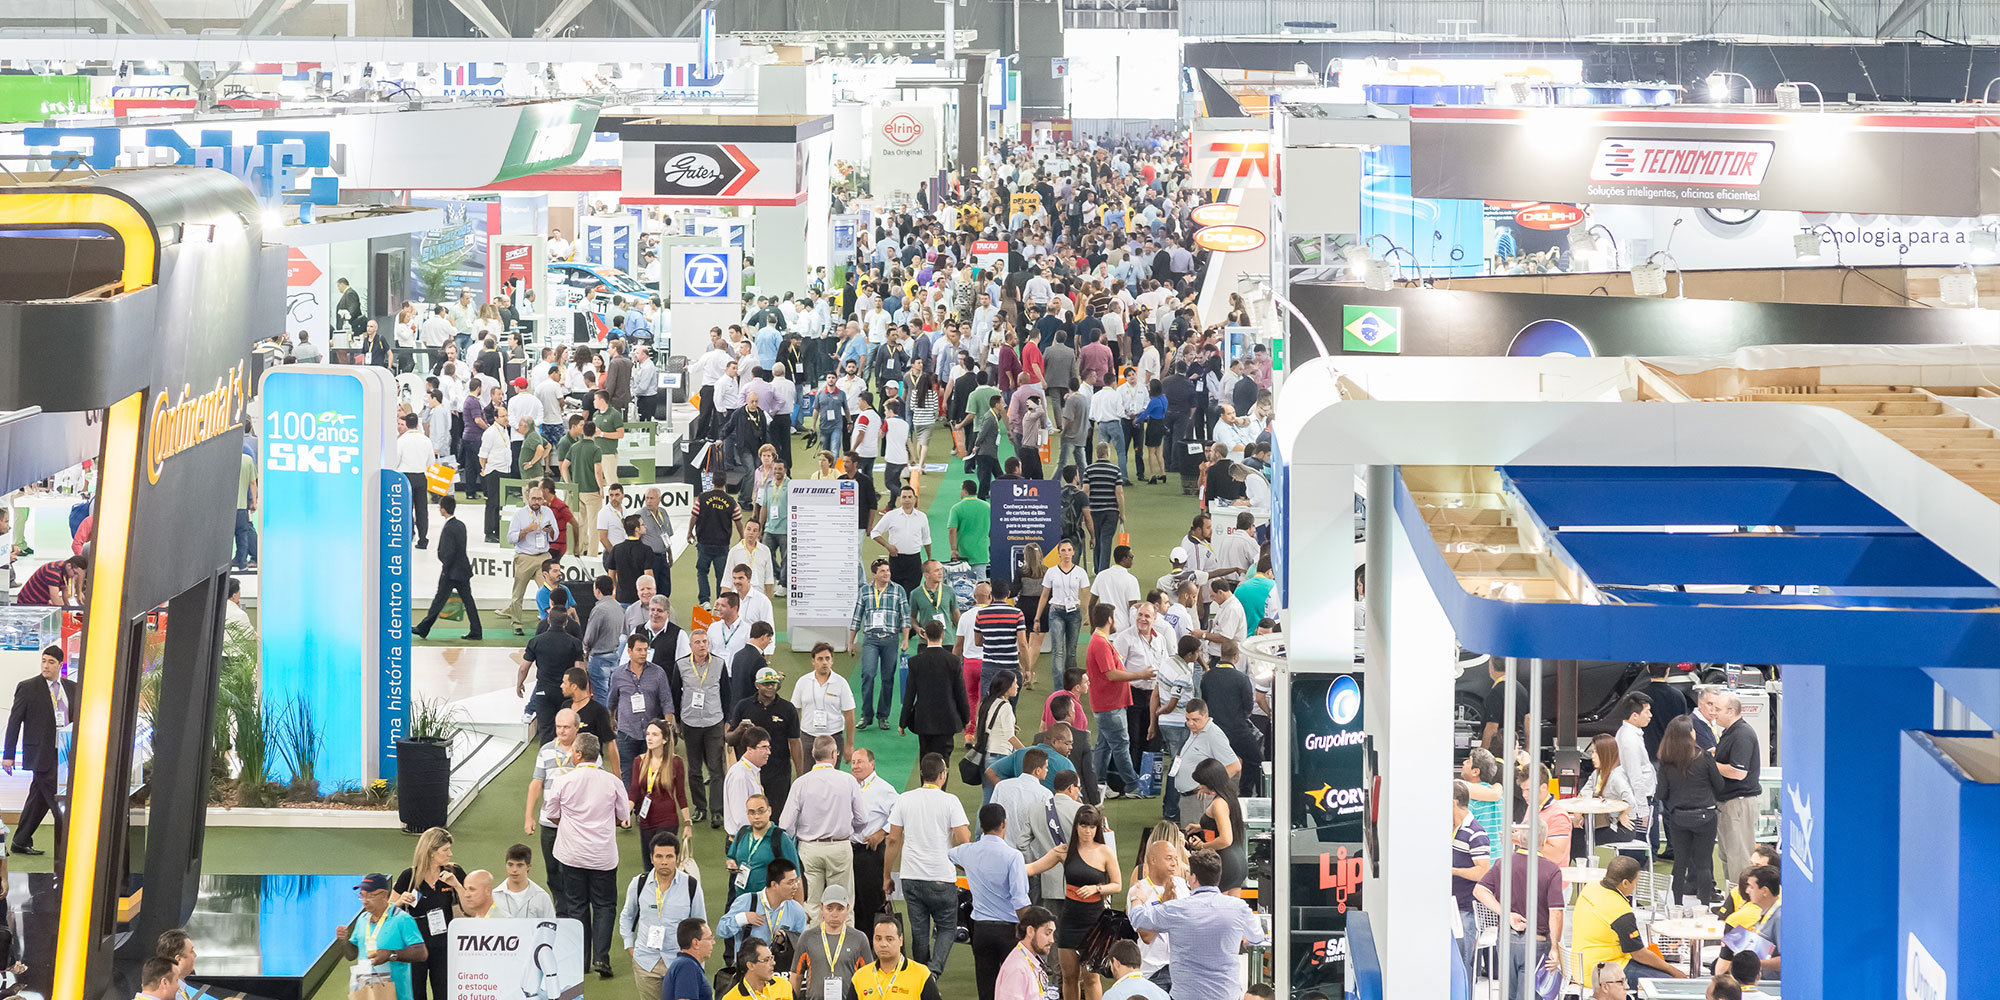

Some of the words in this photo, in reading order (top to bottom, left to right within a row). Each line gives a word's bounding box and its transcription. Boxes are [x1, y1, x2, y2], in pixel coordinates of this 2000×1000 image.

[884, 123, 921, 135] elring
[896, 149, 923, 157] Original
[664, 156, 720, 182] Gates
[1640, 149, 1758, 176] TECNOMOTOR
[1587, 185, 1625, 197] Soluções
[1626, 186, 1679, 199] inteligentes,
[1681, 188, 1714, 199] oficinas
[1716, 190, 1761, 201] eficientes!
[1523, 212, 1576, 221] DELPHI
[1909, 231, 1950, 246] para
[1955, 231, 1966, 243] a
[148, 366, 243, 485] Continental
[267, 411, 315, 441] 100
[316, 426, 359, 442] anos
[792, 487, 837, 495] AUTOMEC
[1013, 484, 1038, 497] bin
[386, 477, 402, 548] história.
[388, 555, 402, 576] da
[387, 583, 402, 640] dentro
[385, 646, 402, 710] história
[457, 936, 519, 951] TAKAO
[457, 972, 489, 980] Girando
